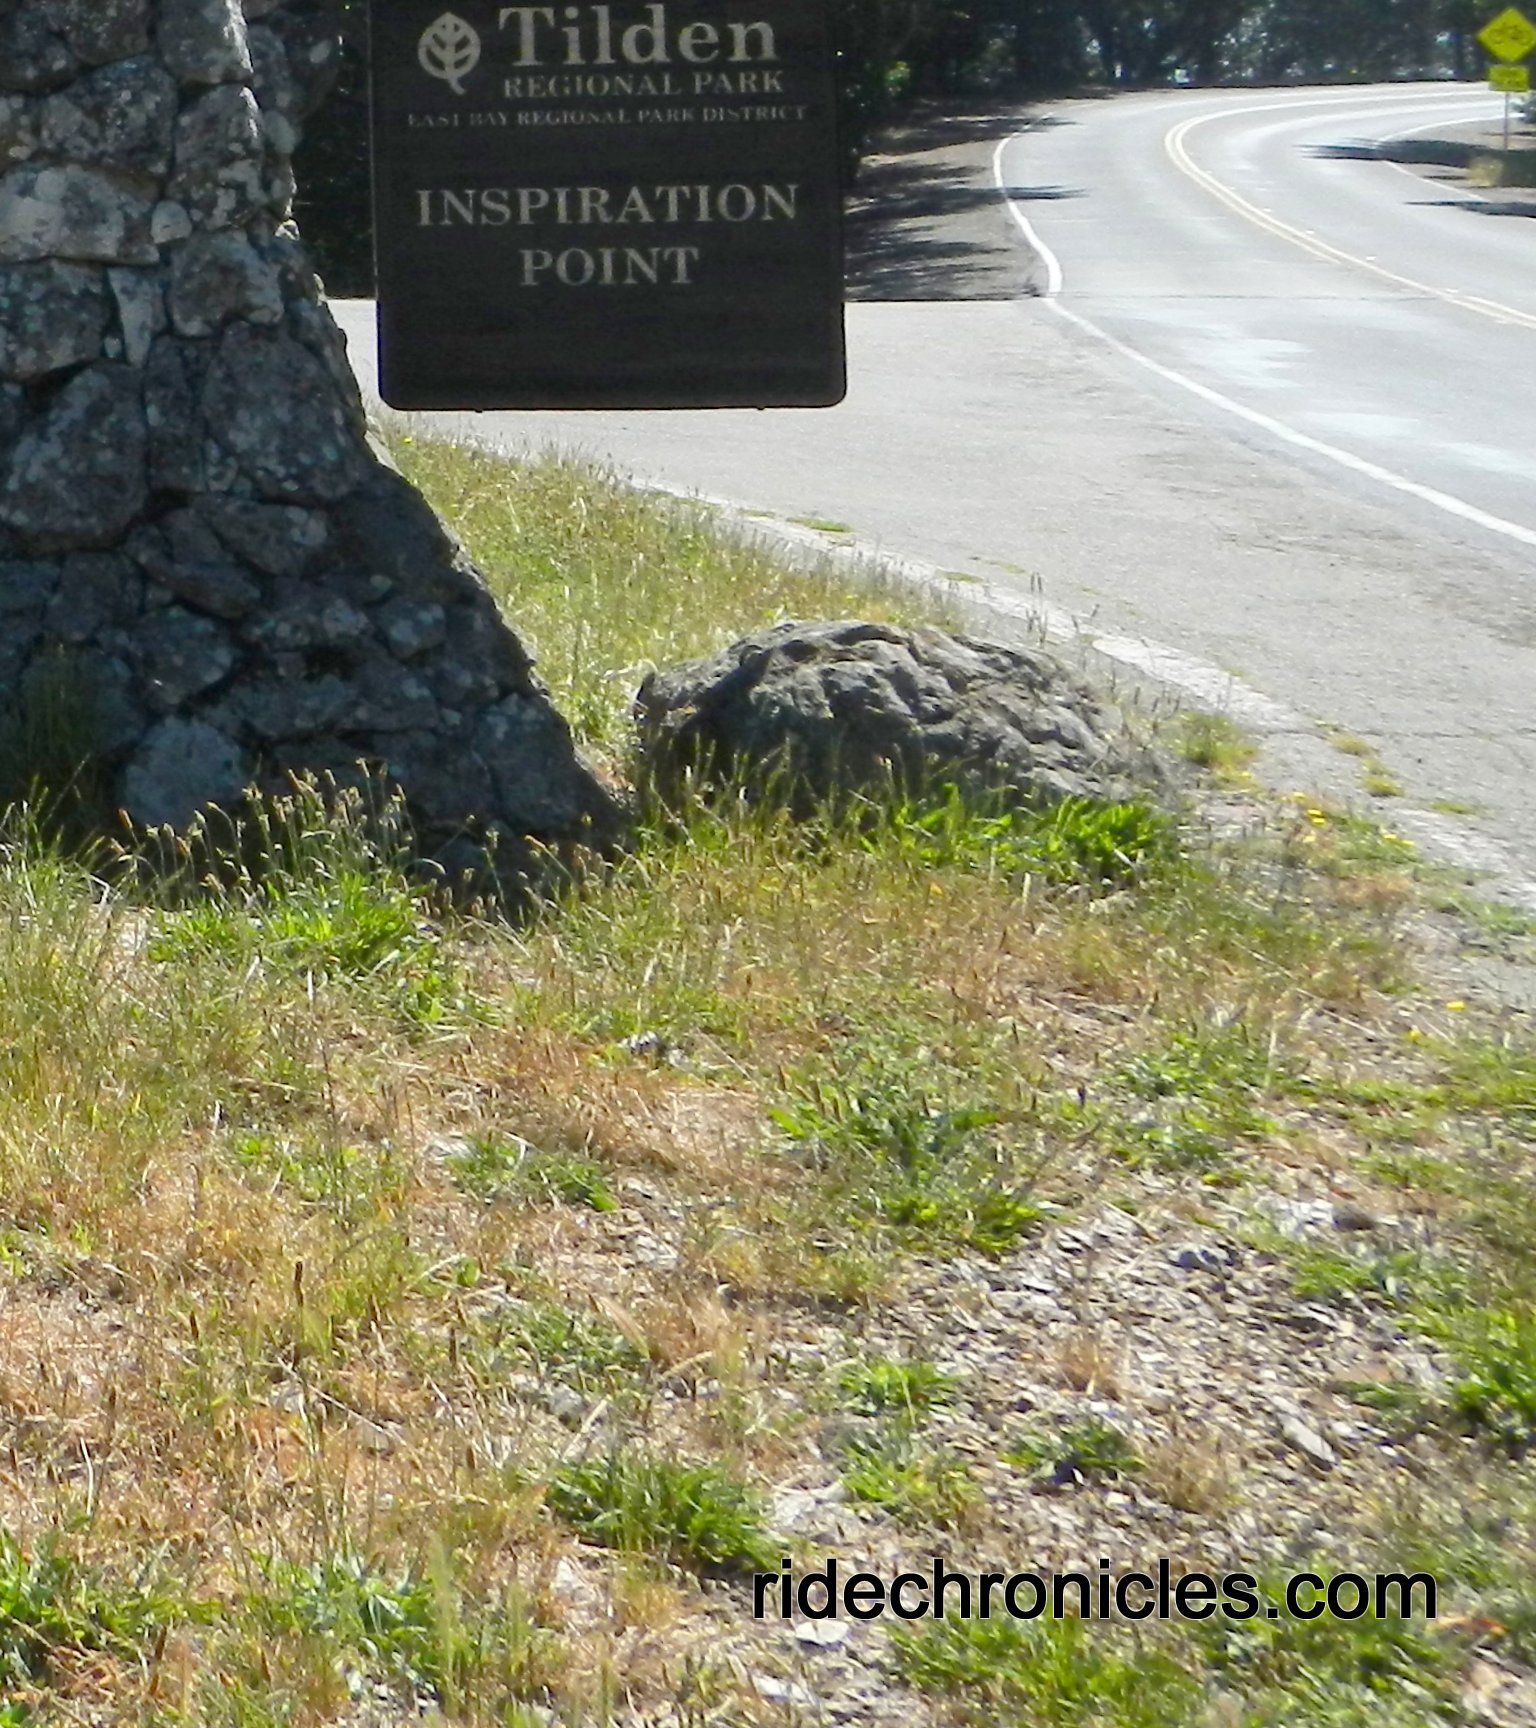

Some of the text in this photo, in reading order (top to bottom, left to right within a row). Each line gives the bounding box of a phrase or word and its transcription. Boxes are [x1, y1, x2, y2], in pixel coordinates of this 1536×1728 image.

[498, 3, 780, 66] Tilden
[503, 70, 784, 99] REGIONAL PARK
[407, 105, 808, 128] EAST BAY REGIONAL PARK DISTRICT
[415, 184, 800, 227] INSPIRATION
[519, 246, 700, 287] POINT
